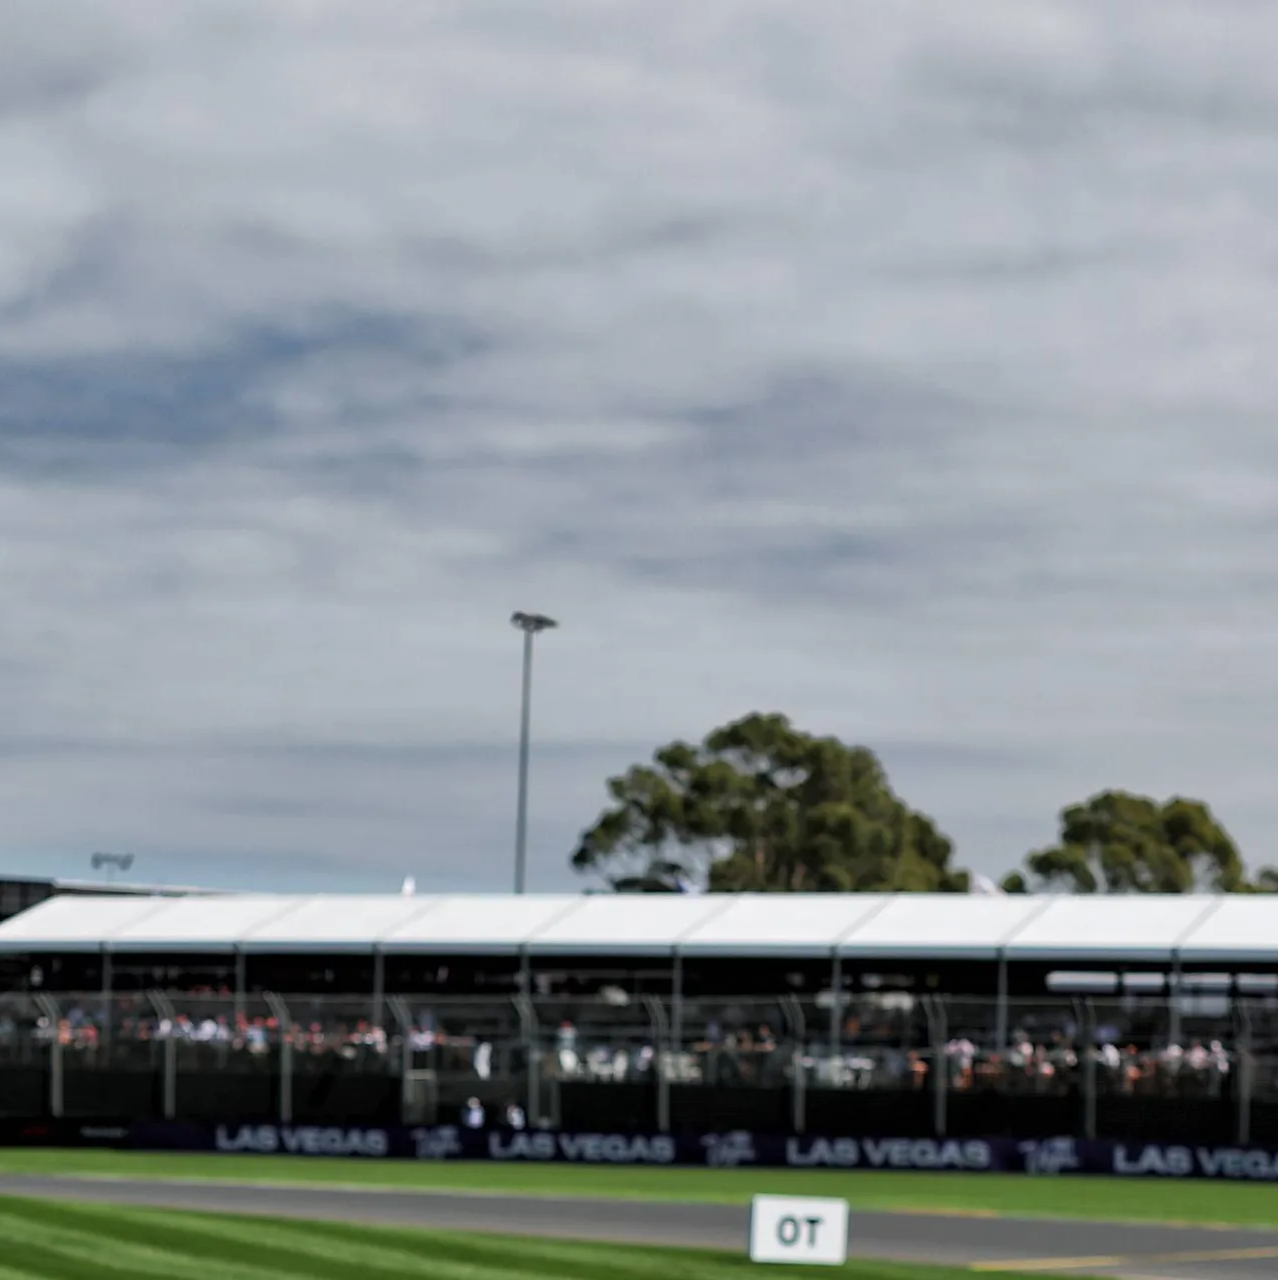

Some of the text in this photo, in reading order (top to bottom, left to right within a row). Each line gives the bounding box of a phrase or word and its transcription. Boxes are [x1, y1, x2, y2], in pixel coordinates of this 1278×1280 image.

[216, 1124, 277, 1151] LAS
[282, 1126, 388, 1156] VEGAS
[488, 1132, 556, 1158] LAS
[559, 1133, 676, 1162] VEGAS
[785, 1138, 857, 1166] LAS
[860, 1138, 991, 1168] VEGAS
[1113, 1144, 1193, 1175] LAS
